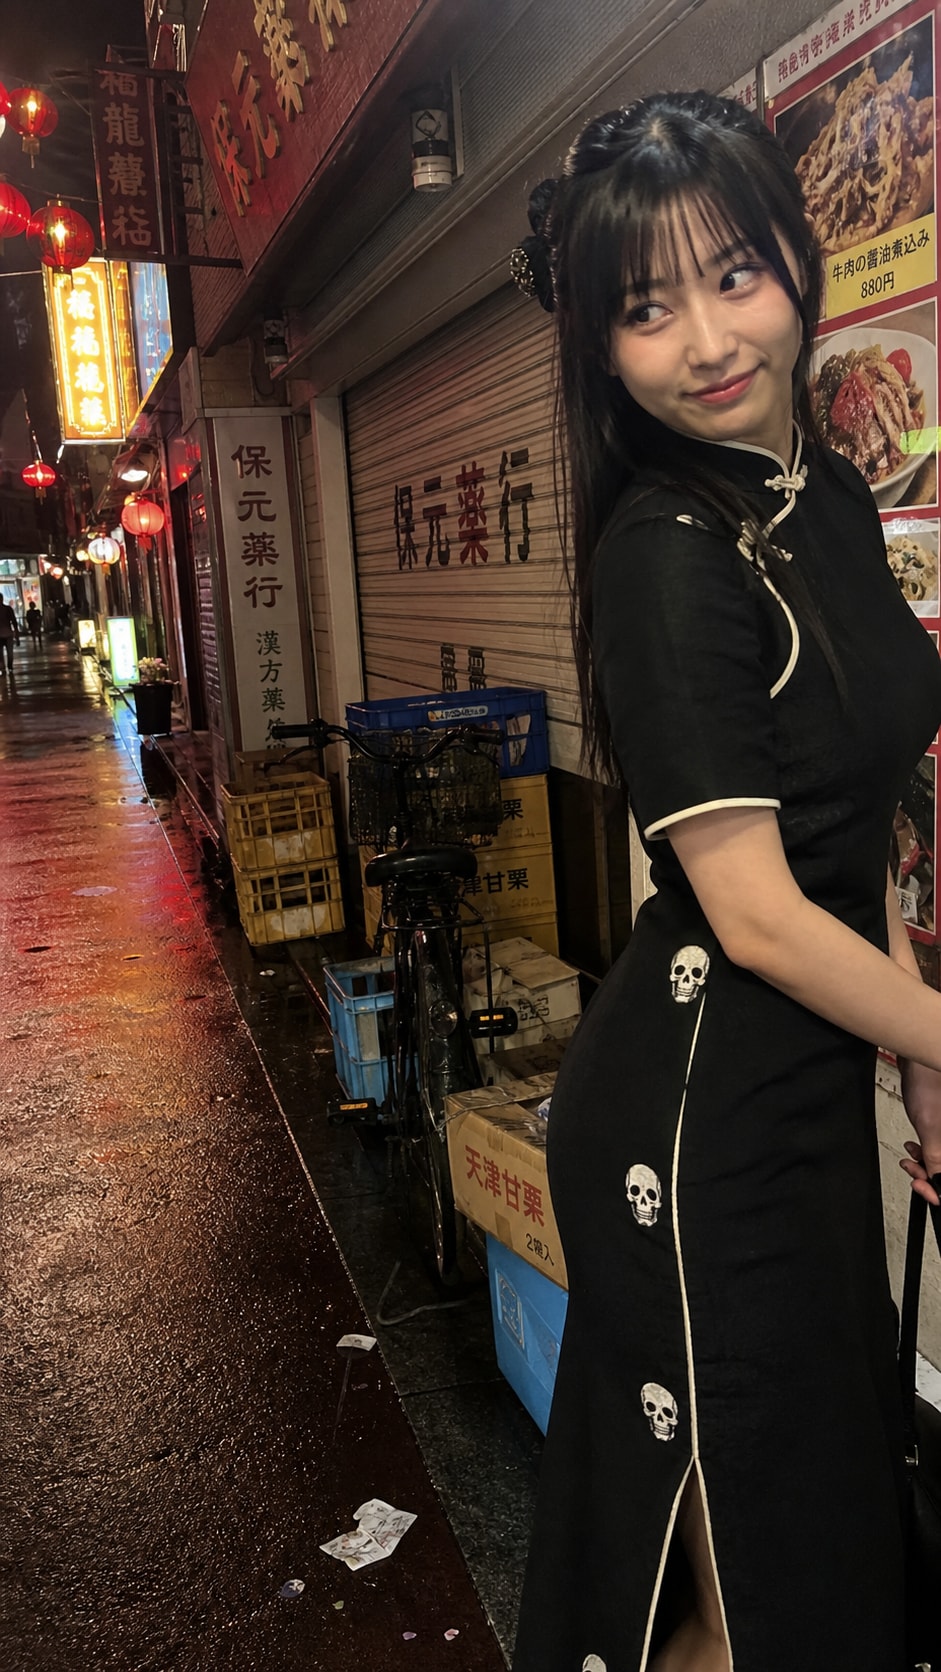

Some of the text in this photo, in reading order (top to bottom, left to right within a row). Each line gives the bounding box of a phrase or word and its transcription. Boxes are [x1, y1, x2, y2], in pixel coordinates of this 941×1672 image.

[861, 271, 895, 299] 880円
[231, 444, 283, 609] 保元薬行
[464, 1144, 545, 1228] 天津甘栗
